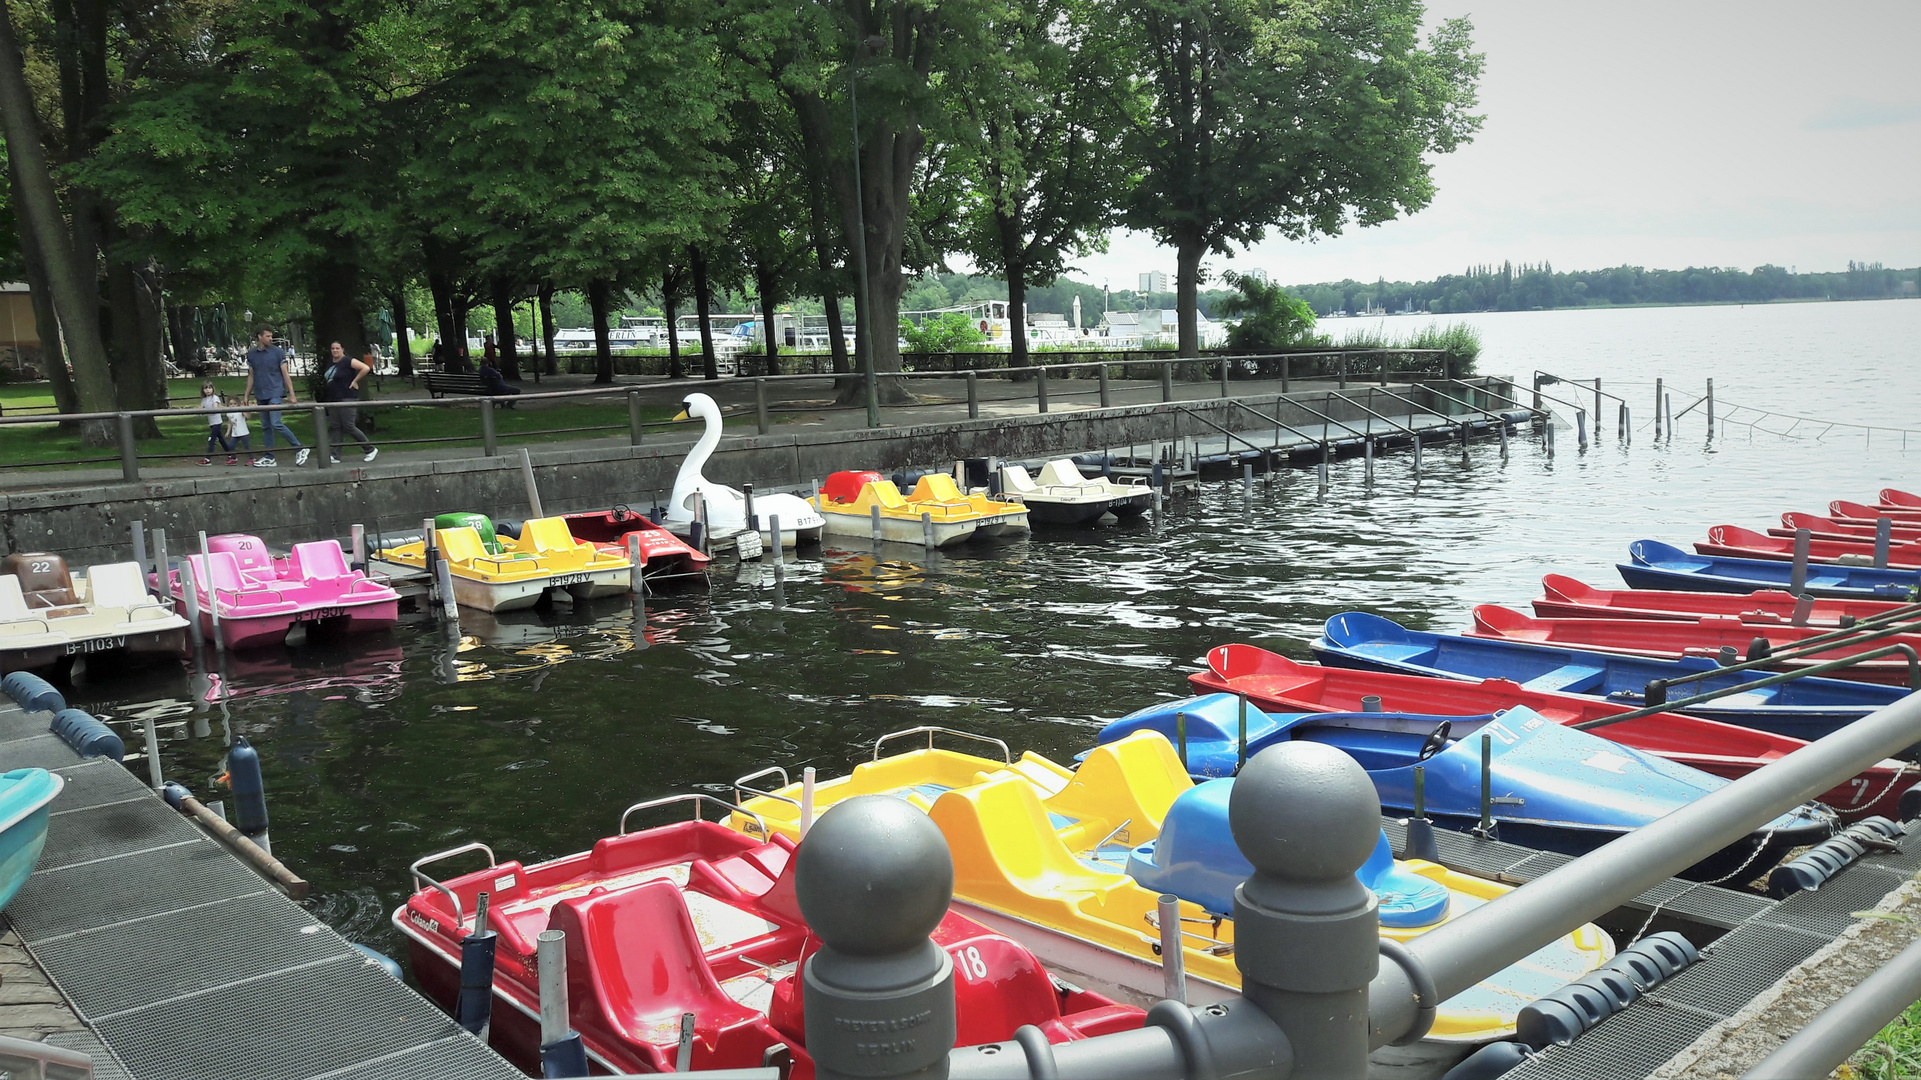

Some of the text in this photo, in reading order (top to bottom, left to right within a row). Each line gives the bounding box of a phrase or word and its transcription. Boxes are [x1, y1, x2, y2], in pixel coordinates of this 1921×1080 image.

[468, 520, 482, 530] 28
[1713, 528, 1725, 543] 12
[238, 541, 252, 550] 20
[31, 562, 50, 573] 22
[1341, 616, 1350, 637] 1
[66, 636, 126, 655] B-1103 V
[1483, 721, 1520, 745] 27
[1850, 778, 1870, 805] 7
[957, 946, 988, 981] 18
[856, 1038, 916, 1056] BERLIN
